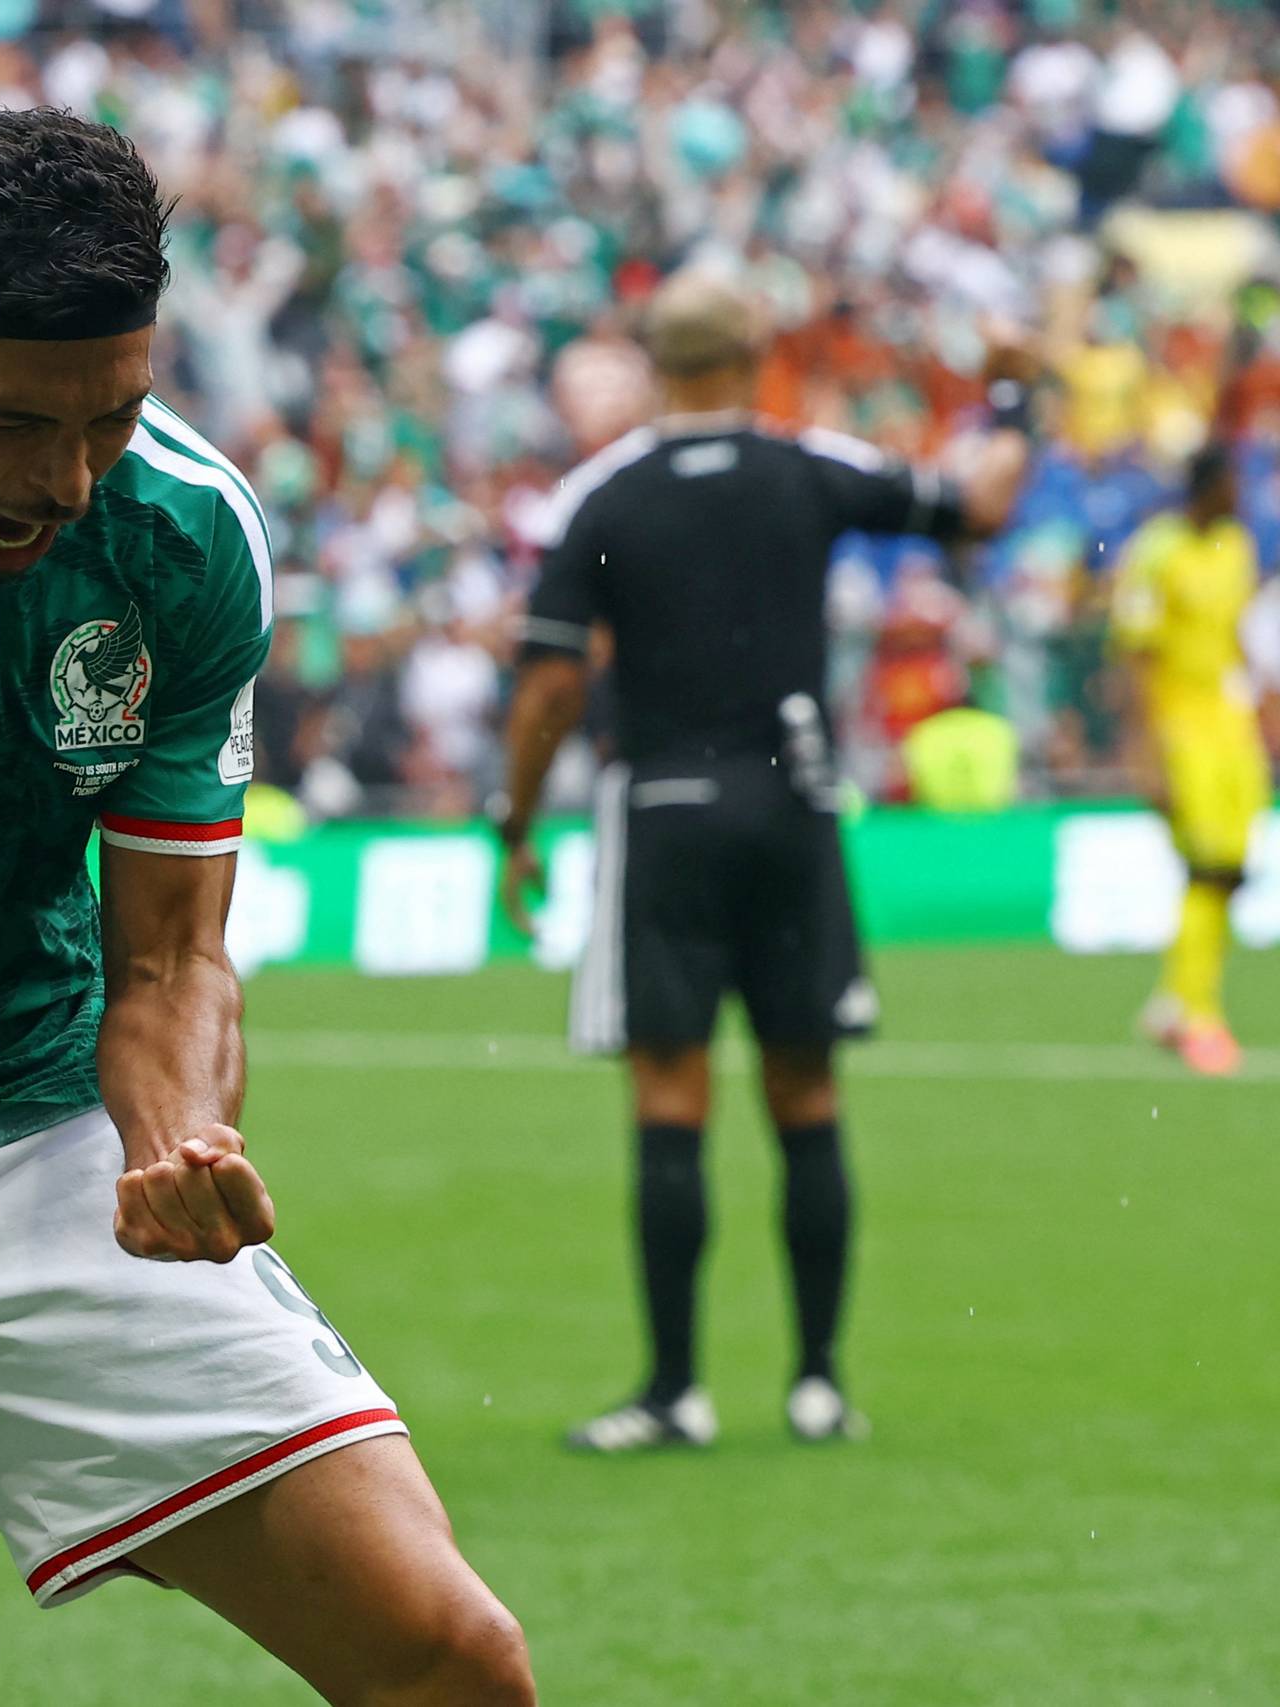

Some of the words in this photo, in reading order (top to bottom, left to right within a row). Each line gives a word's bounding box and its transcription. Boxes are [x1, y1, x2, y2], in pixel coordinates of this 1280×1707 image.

[58, 722, 141, 747] MÉXICO
[95, 762, 117, 775] SOUTH
[75, 775, 83, 786] 11
[252, 1248, 362, 1378] 9
